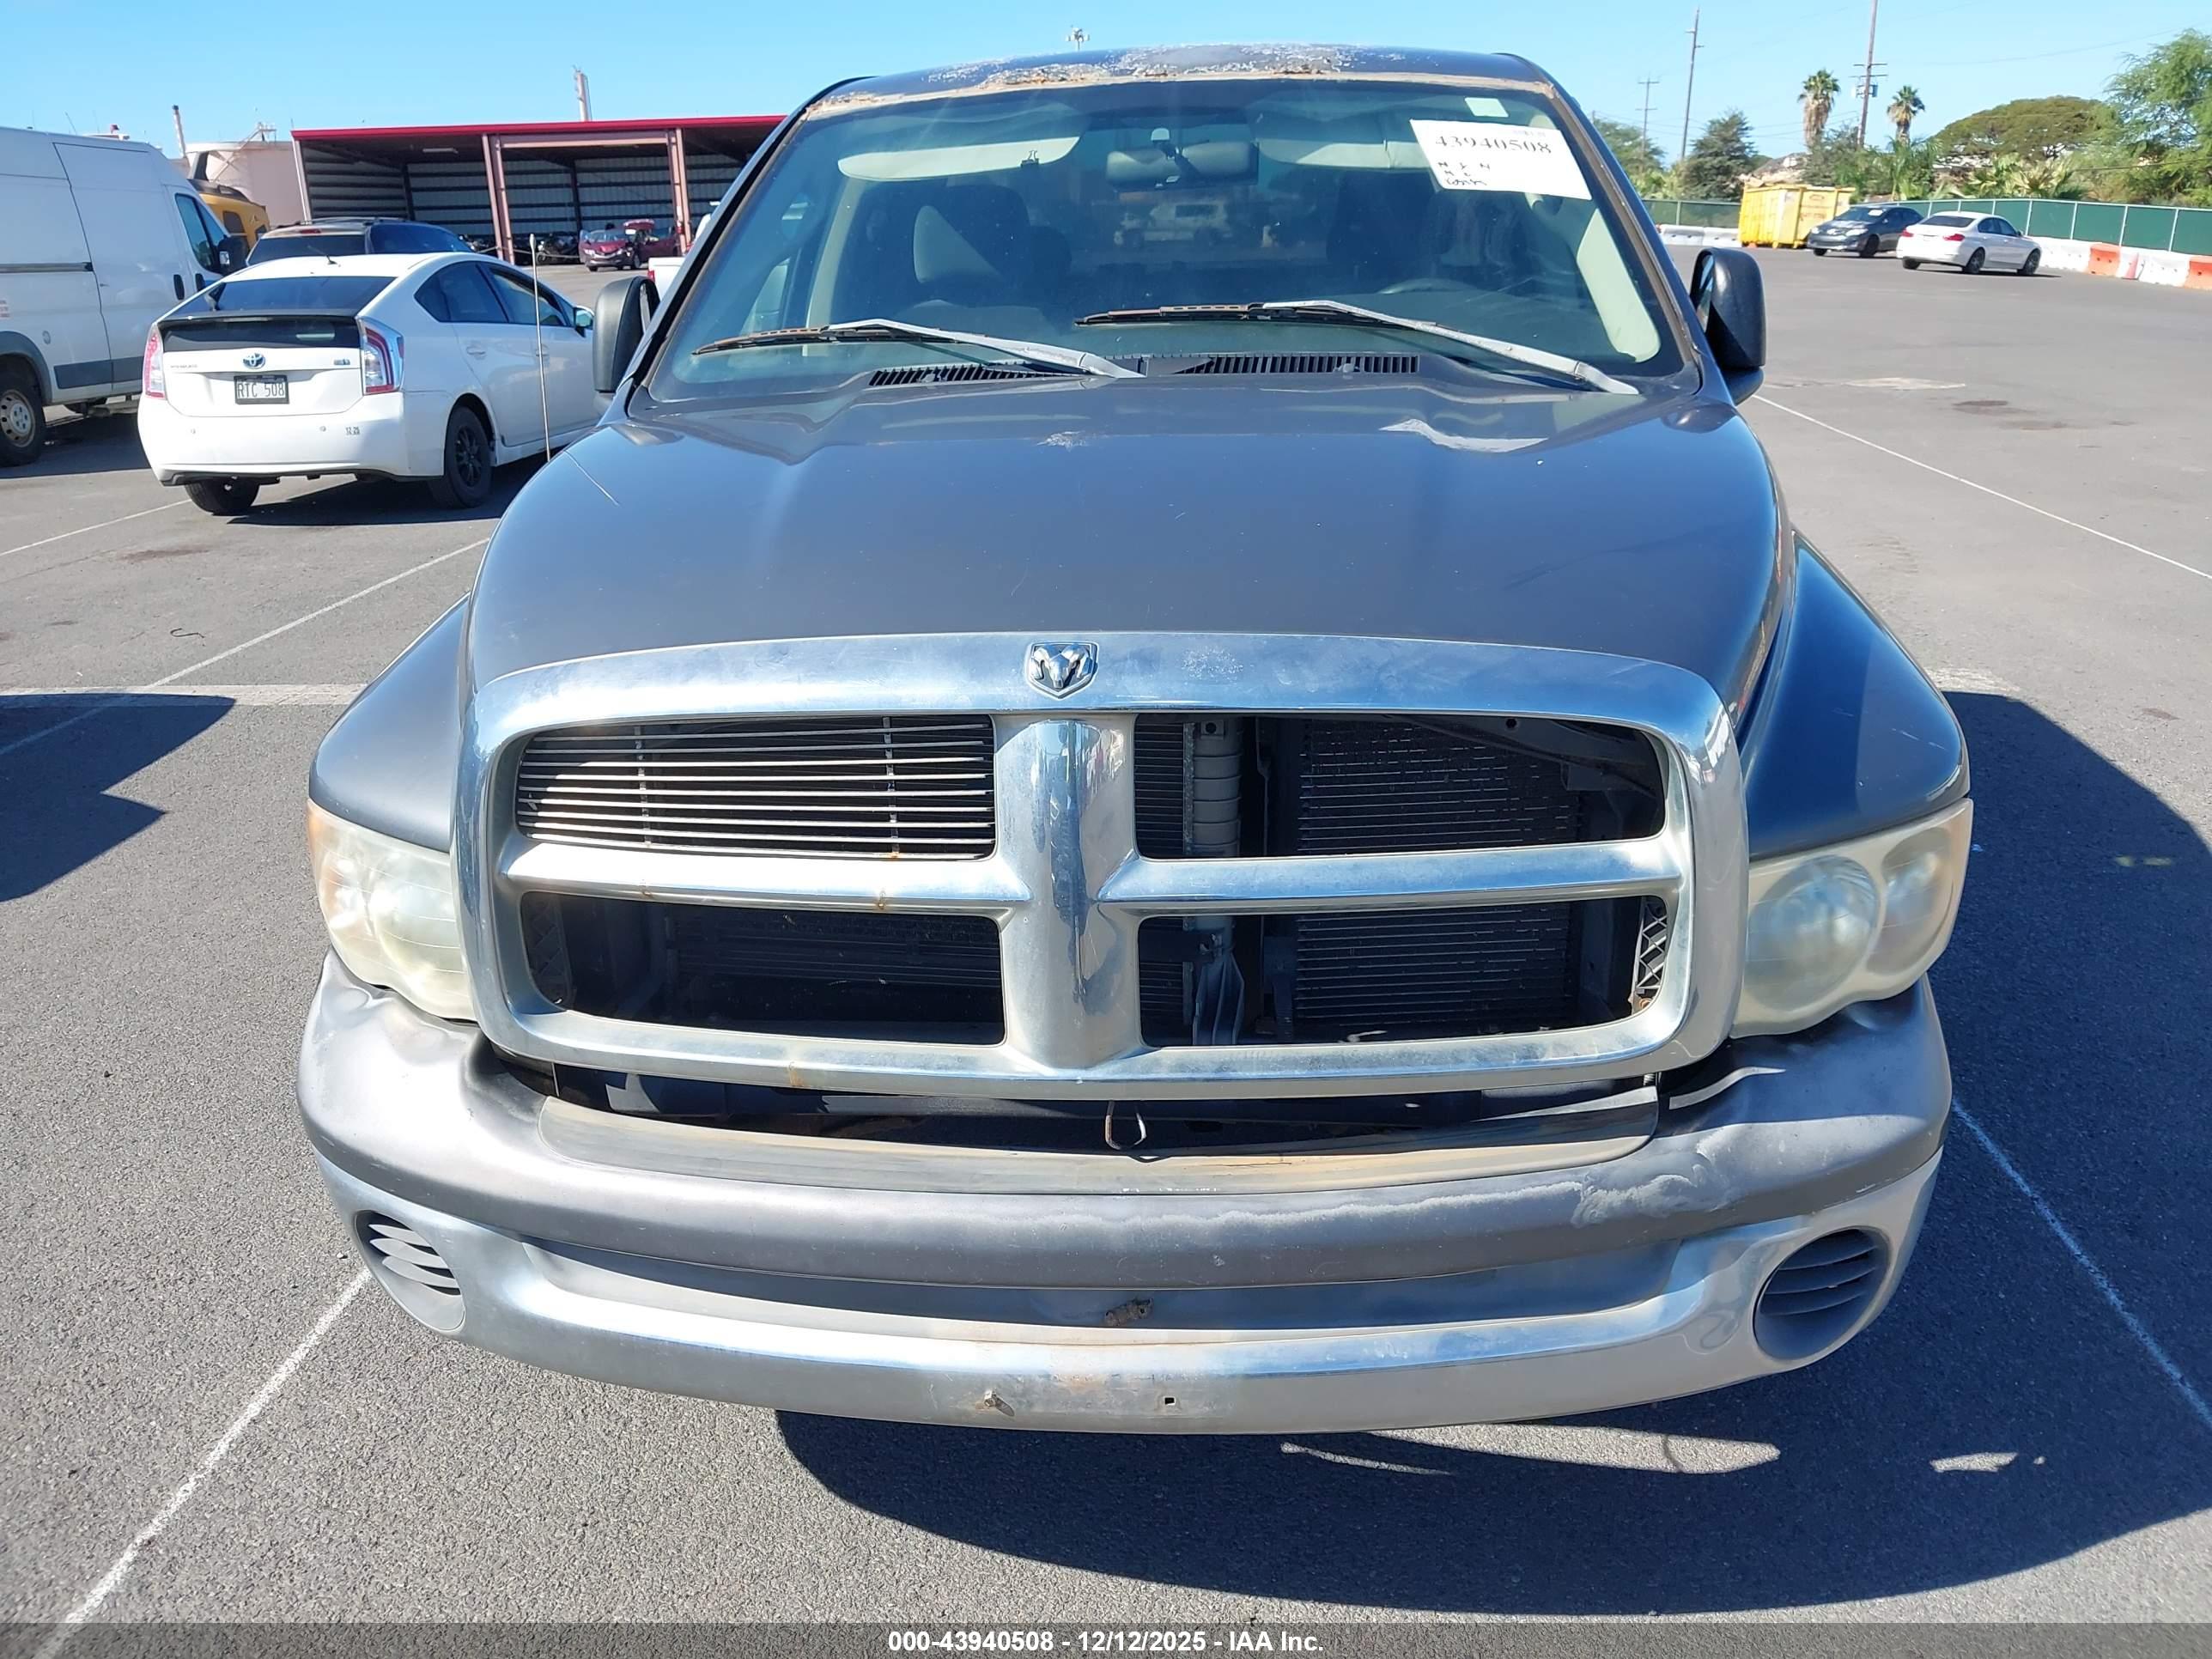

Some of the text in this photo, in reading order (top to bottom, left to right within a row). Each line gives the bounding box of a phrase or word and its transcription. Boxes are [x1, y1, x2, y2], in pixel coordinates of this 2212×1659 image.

[1435, 136, 1552, 154] 43940508
[237, 382, 285, 398] RTC 508
